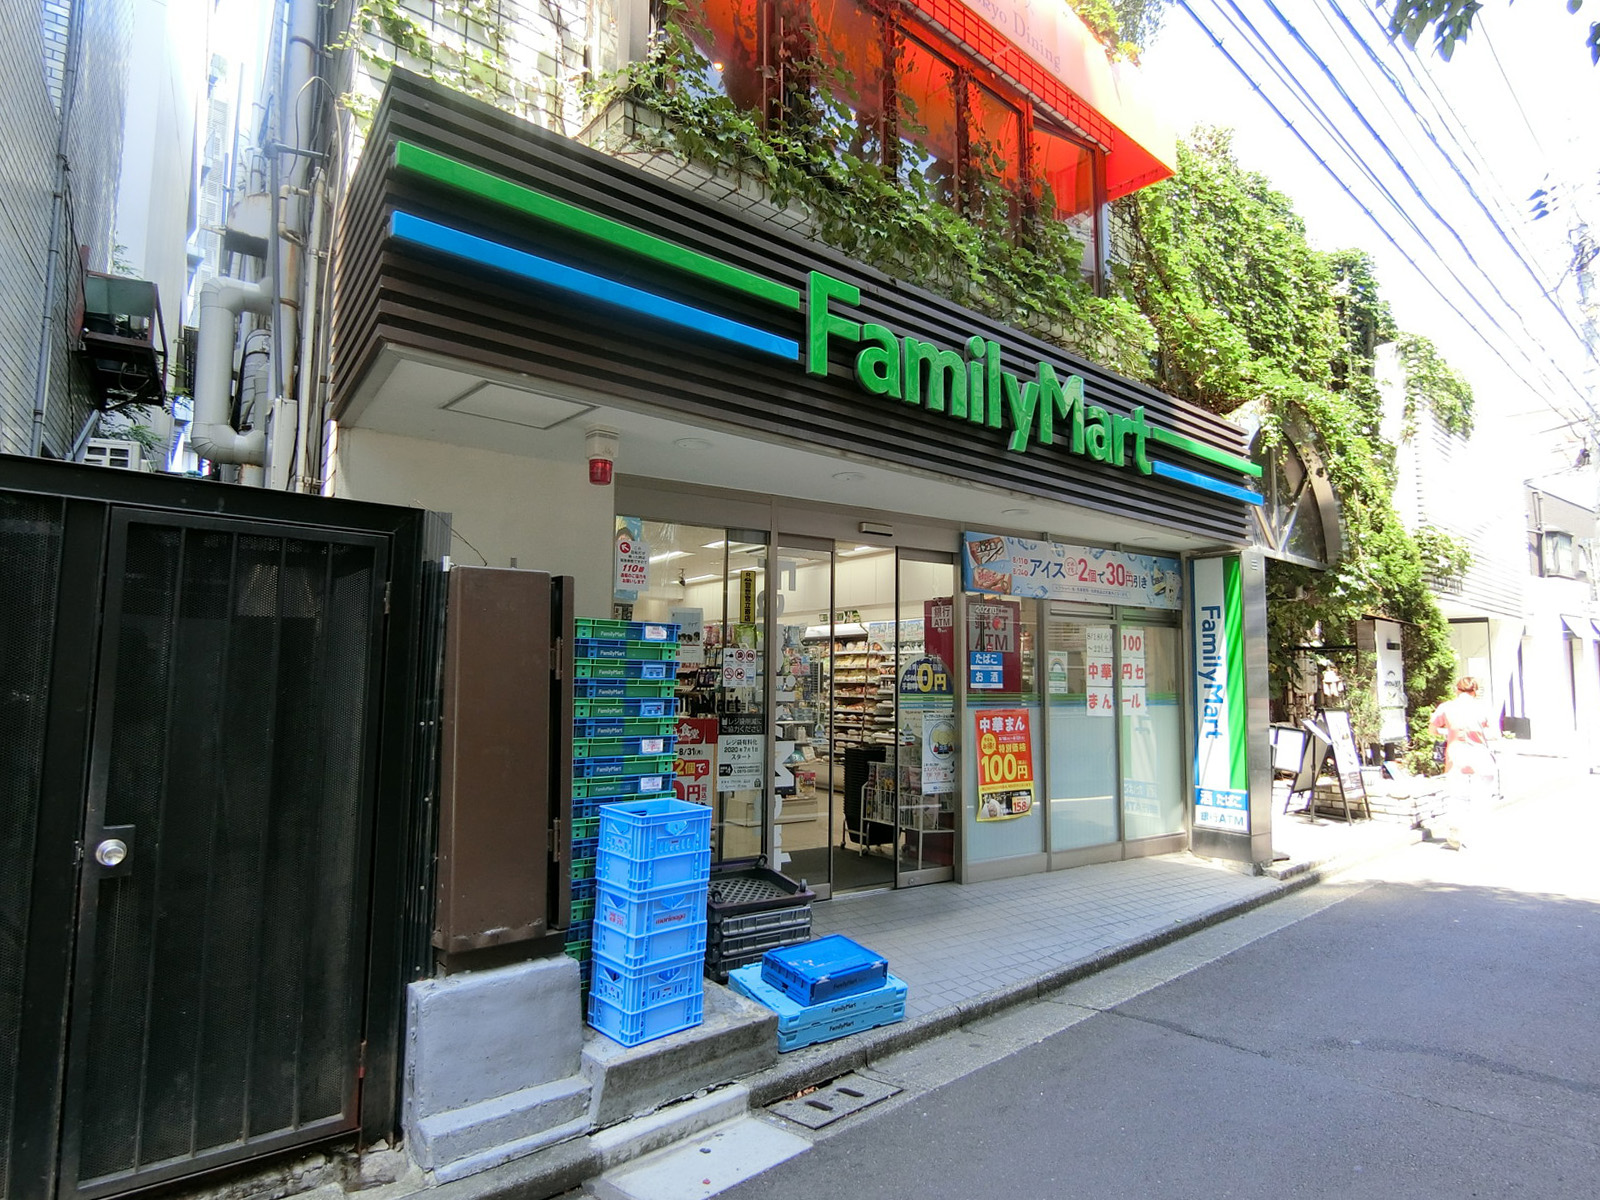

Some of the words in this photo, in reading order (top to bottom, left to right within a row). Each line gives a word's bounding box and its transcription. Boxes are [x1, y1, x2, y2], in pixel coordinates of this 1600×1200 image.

[1013, 10, 1061, 73] Dining
[806, 270, 1152, 475] FamilyMart
[1029, 559, 1067, 579] アイス
[933, 618, 950, 627] ATM
[600, 630, 626, 638] FamilyMart
[975, 634, 1008, 651] ATM
[1123, 634, 1142, 651] 100
[975, 653, 998, 664] たばこ
[917, 663, 947, 692] 0円
[1088, 662, 1112, 680] 中華
[1198, 605, 1223, 739] FamilyMart
[598, 688, 624, 696] FamilyMart
[1088, 693, 1112, 709] まん
[597, 727, 623, 735] FamilyMart
[721, 725, 763, 733] ご協力ください
[979, 717, 1025, 733] 中華まん
[998, 743, 1027, 754] 特別価格
[674, 758, 706, 775] 2個で
[981, 753, 1028, 783] 100円
[1013, 801, 1027, 812] 158
[831, 1002, 857, 1013] FamilyMart
[829, 1020, 855, 1032] FamilyMart
